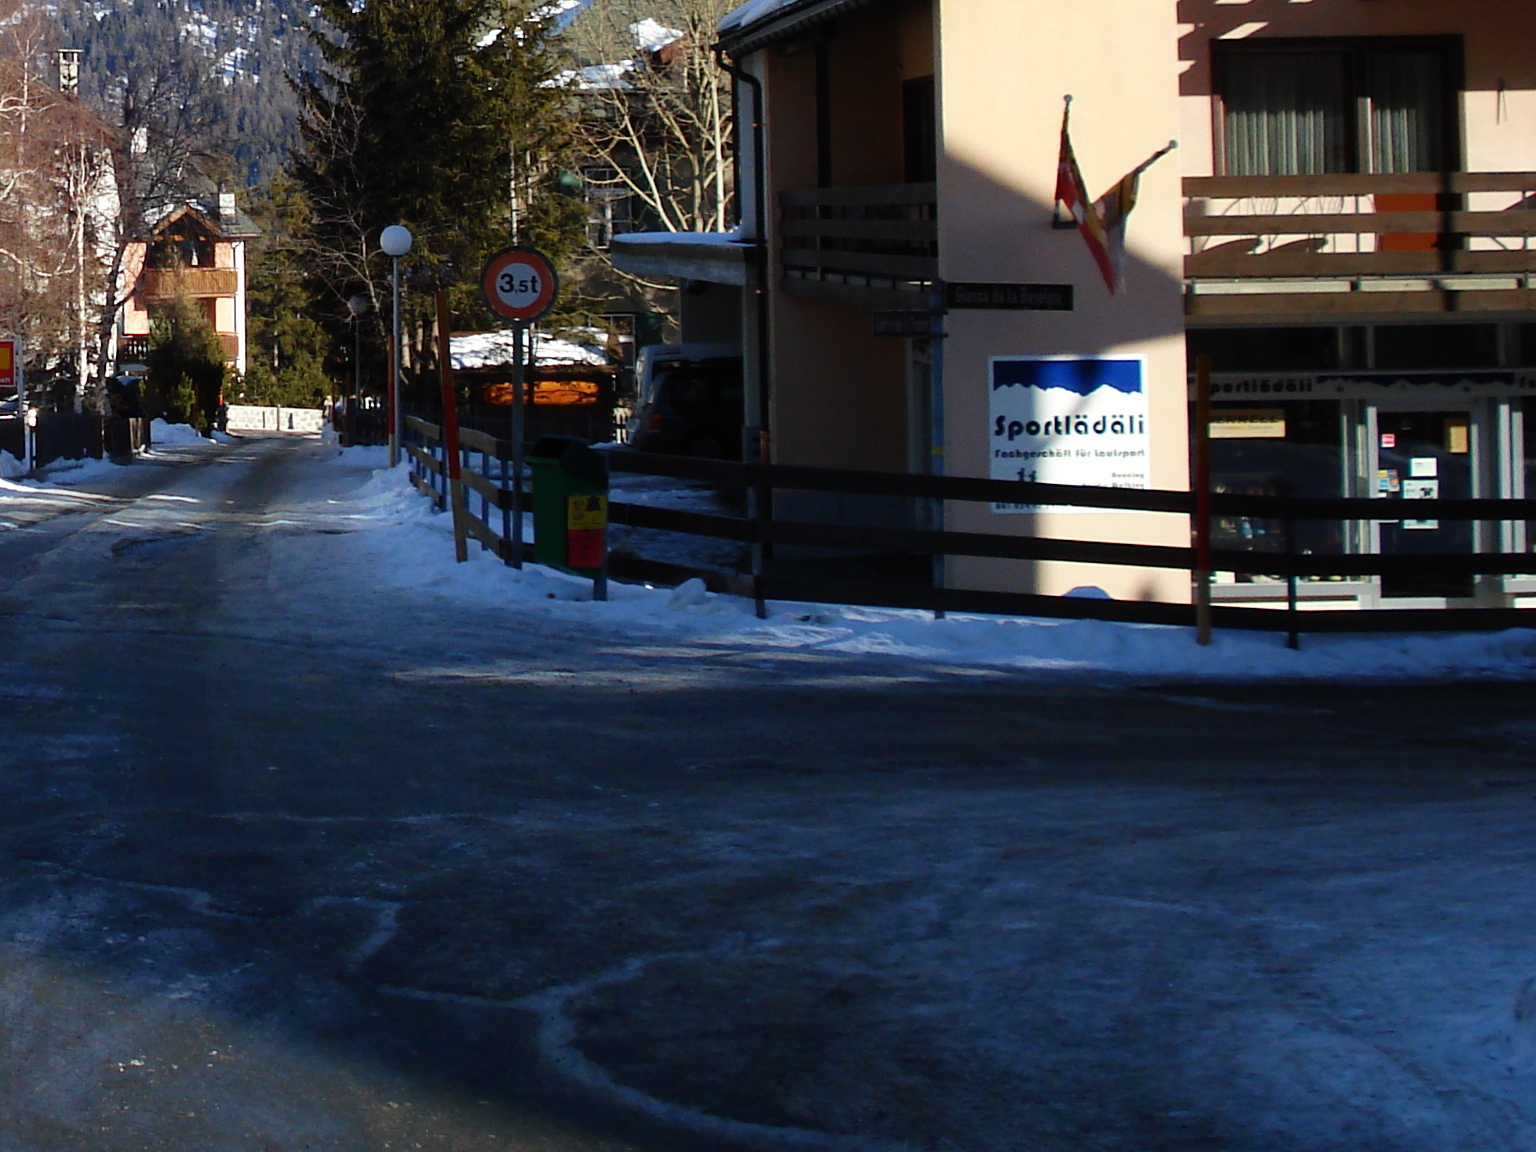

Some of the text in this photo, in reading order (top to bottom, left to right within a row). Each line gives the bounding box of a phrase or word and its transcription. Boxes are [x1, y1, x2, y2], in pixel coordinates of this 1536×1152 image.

[1208, 378, 1313, 397] portlädäli
[994, 414, 1145, 441] Sportlädäli
[1075, 449, 1091, 458] für
